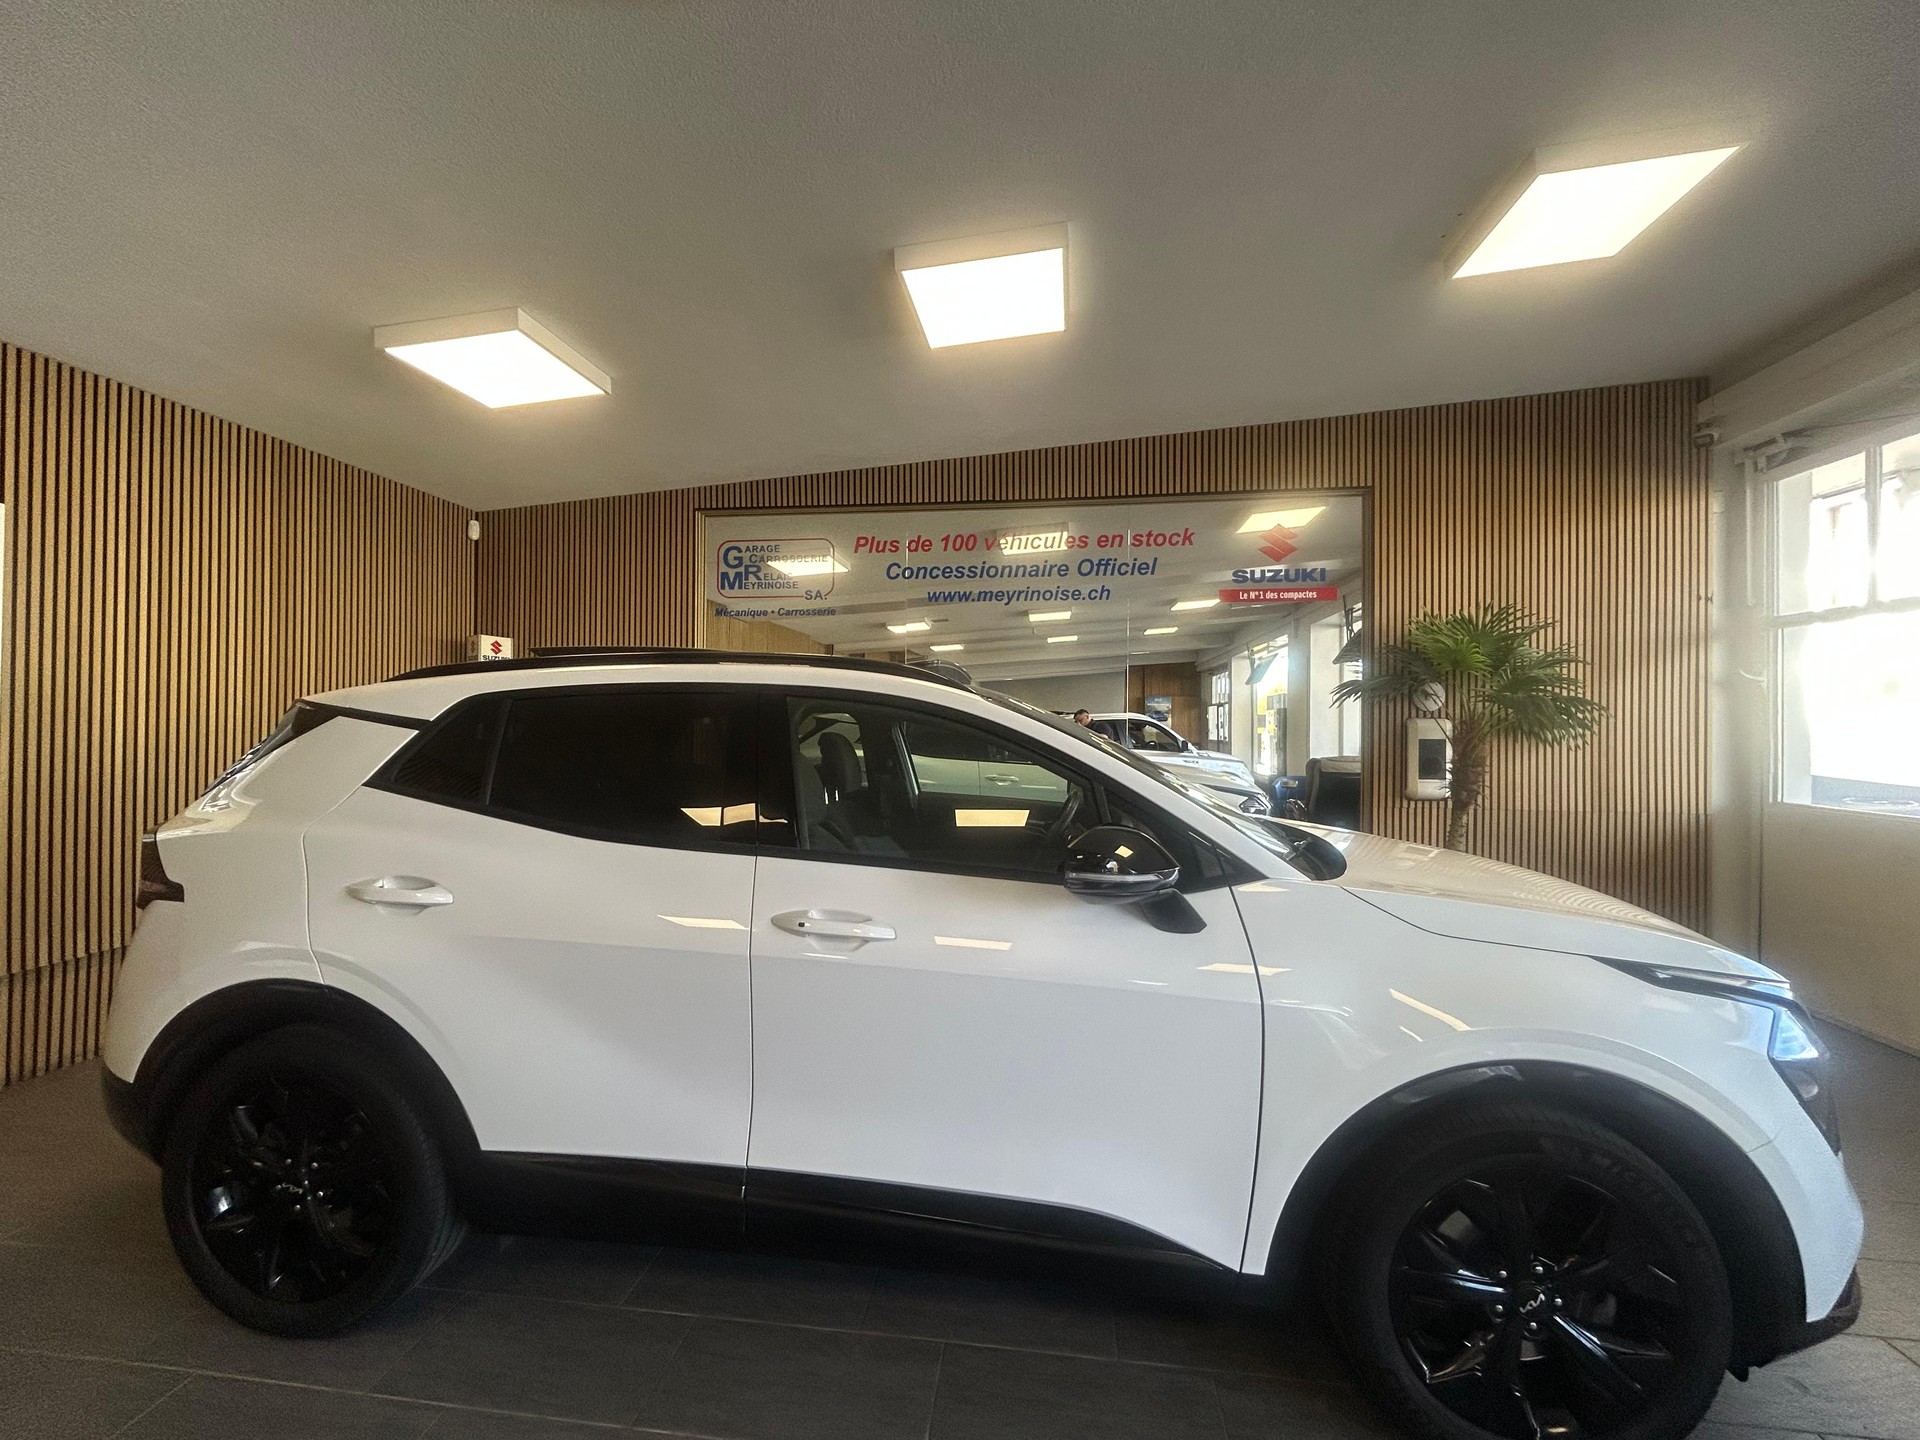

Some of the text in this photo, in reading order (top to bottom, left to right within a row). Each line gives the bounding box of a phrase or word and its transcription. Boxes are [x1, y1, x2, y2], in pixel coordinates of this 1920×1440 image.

[854, 528, 1195, 553] Plus de 100 véhicules en stock
[886, 557, 1158, 580] Concessionnaire Officiel
[1232, 567, 1326, 584] SUZUKI
[927, 585, 1111, 606] www.meyrinoise.ch
[1239, 591, 1248, 600] Le
[1265, 590, 1278, 599] des
[1279, 590, 1317, 600] compactes
[715, 607, 837, 618] Mécanique Carrosserie
